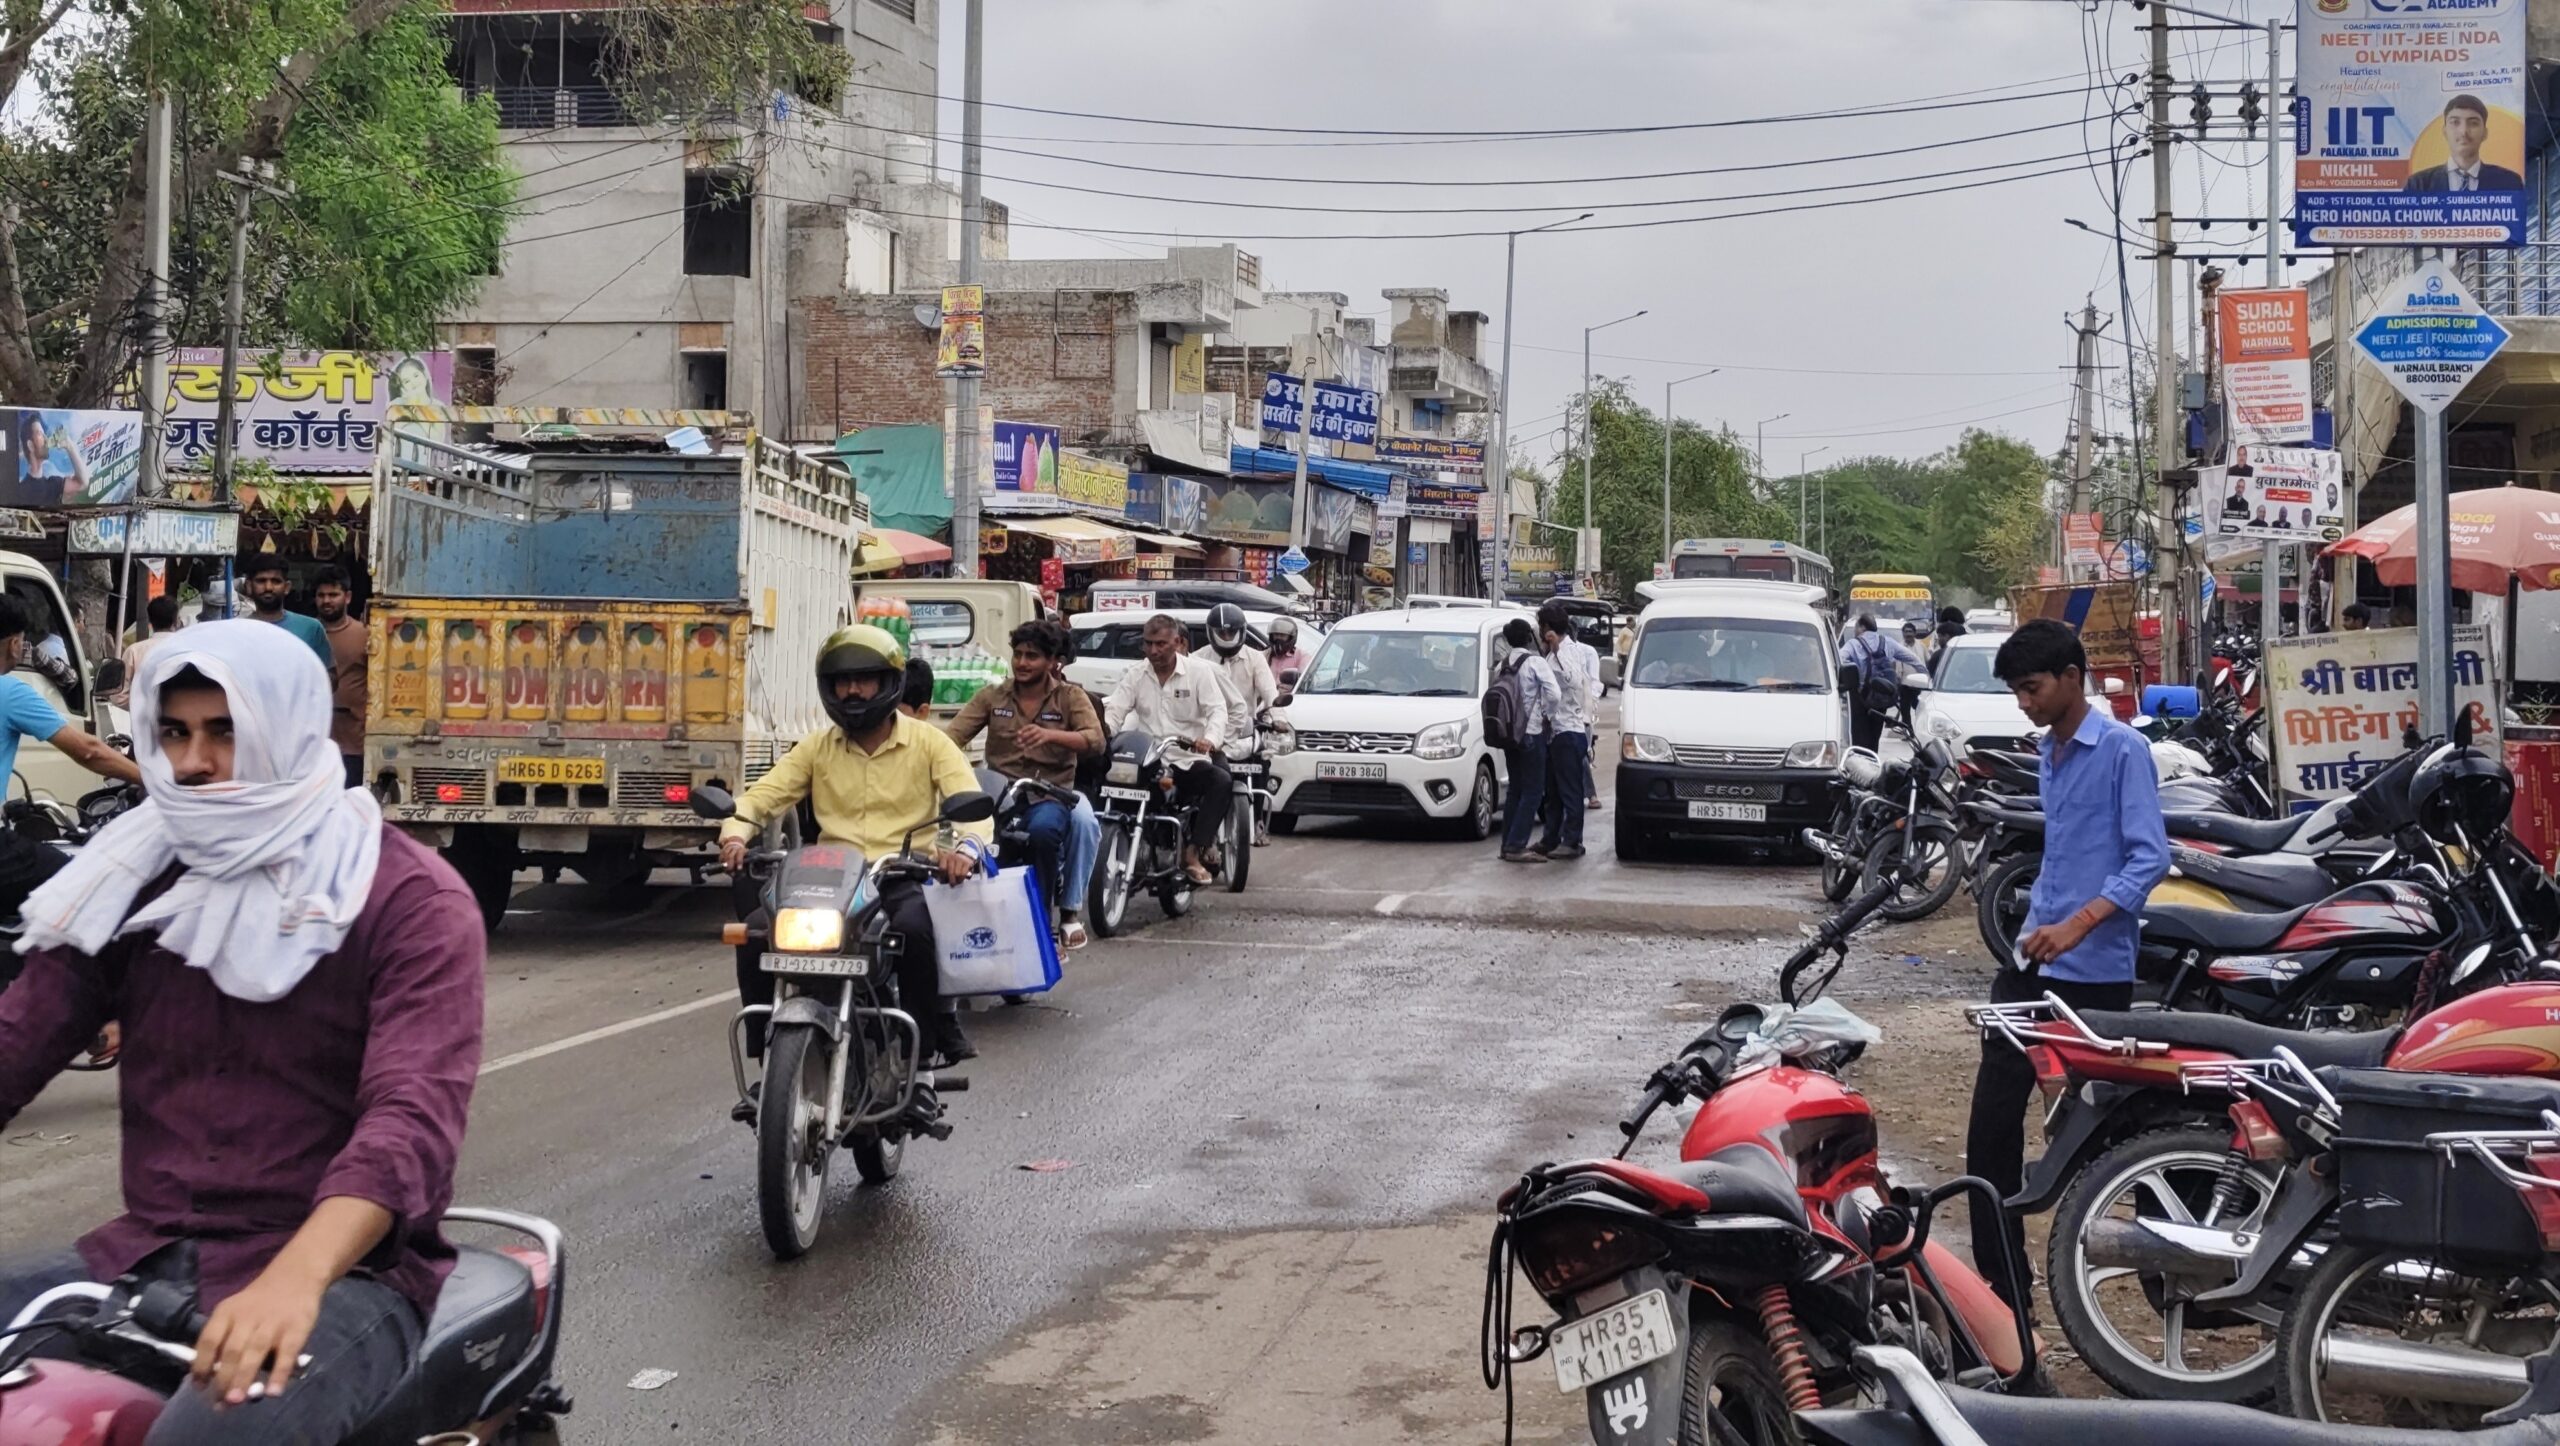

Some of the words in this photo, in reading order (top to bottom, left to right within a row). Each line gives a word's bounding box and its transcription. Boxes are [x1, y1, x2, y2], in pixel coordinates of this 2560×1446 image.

[2320, 33, 2371, 46] NEET
[2382, 32, 2447, 45] IIT-JEE
[2458, 30, 2500, 44] NDA
[2355, 48, 2470, 63] OLYMPIADS
[2340, 66, 2381, 76] Heartiest
[2328, 107, 2395, 145] IIT
[2371, 146, 2399, 157] KERLA
[2320, 163, 2378, 177] NIKHIL
[2330, 179, 2372, 187] YOGENDER
[2373, 179, 2398, 187] SINGH
[2331, 196, 2344, 205] 1ST
[2446, 195, 2487, 205] SUBHASH
[2489, 195, 2513, 204] PARK
[2301, 210, 2339, 223] HERO
[2342, 209, 2391, 223] HONDA
[2395, 209, 2448, 224] CHOWK,
[2452, 208, 2519, 222] NARNAUL
[2421, 228, 2502, 239] 9992334866
[2406, 293, 2460, 306] Aakash
[2236, 300, 2294, 320] SURAJ
[2238, 320, 2295, 334] SCHOOL
[2386, 318, 2450, 329] ADMISSIONS
[2452, 317, 2478, 328] OPEN
[2241, 336, 2293, 349] NARNAUL
[2371, 335, 2398, 345] NEET
[2405, 334, 2423, 343] JEE
[2431, 333, 2493, 343] FOUNDATION
[2380, 350, 2394, 358] Get
[2407, 350, 2415, 358] to
[2416, 346, 2440, 358] 90%
[2443, 350, 2486, 359] Scholarship
[2393, 364, 2438, 373] NARNAUL
[2438, 364, 2473, 373] BRANCH
[2406, 374, 2462, 383] 8800013042
[1294, 409, 1326, 432] दाई
[1325, 412, 1343, 434] की
[253, 409, 380, 450] कॉर्नर
[993, 432, 1015, 463] mul
[1851, 590, 1901, 599] SCHOOL
[1904, 590, 1929, 599] BUS
[2300, 659, 2345, 696] श्री
[508, 761, 546, 778] HR66
[551, 763, 560, 778] D
[565, 764, 603, 779] 6263
[1324, 765, 1335, 776] HR
[1360, 767, 1383, 778] 3840
[1704, 785, 1755, 795] EECO
[1696, 805, 1724, 817] HR35
[1727, 806, 1734, 818] T
[1738, 808, 1764, 819] 1501
[2396, 893, 2429, 906] Hero
[1578, 1303, 1644, 1352] HR35
[1577, 1329, 1659, 1383] K1191
